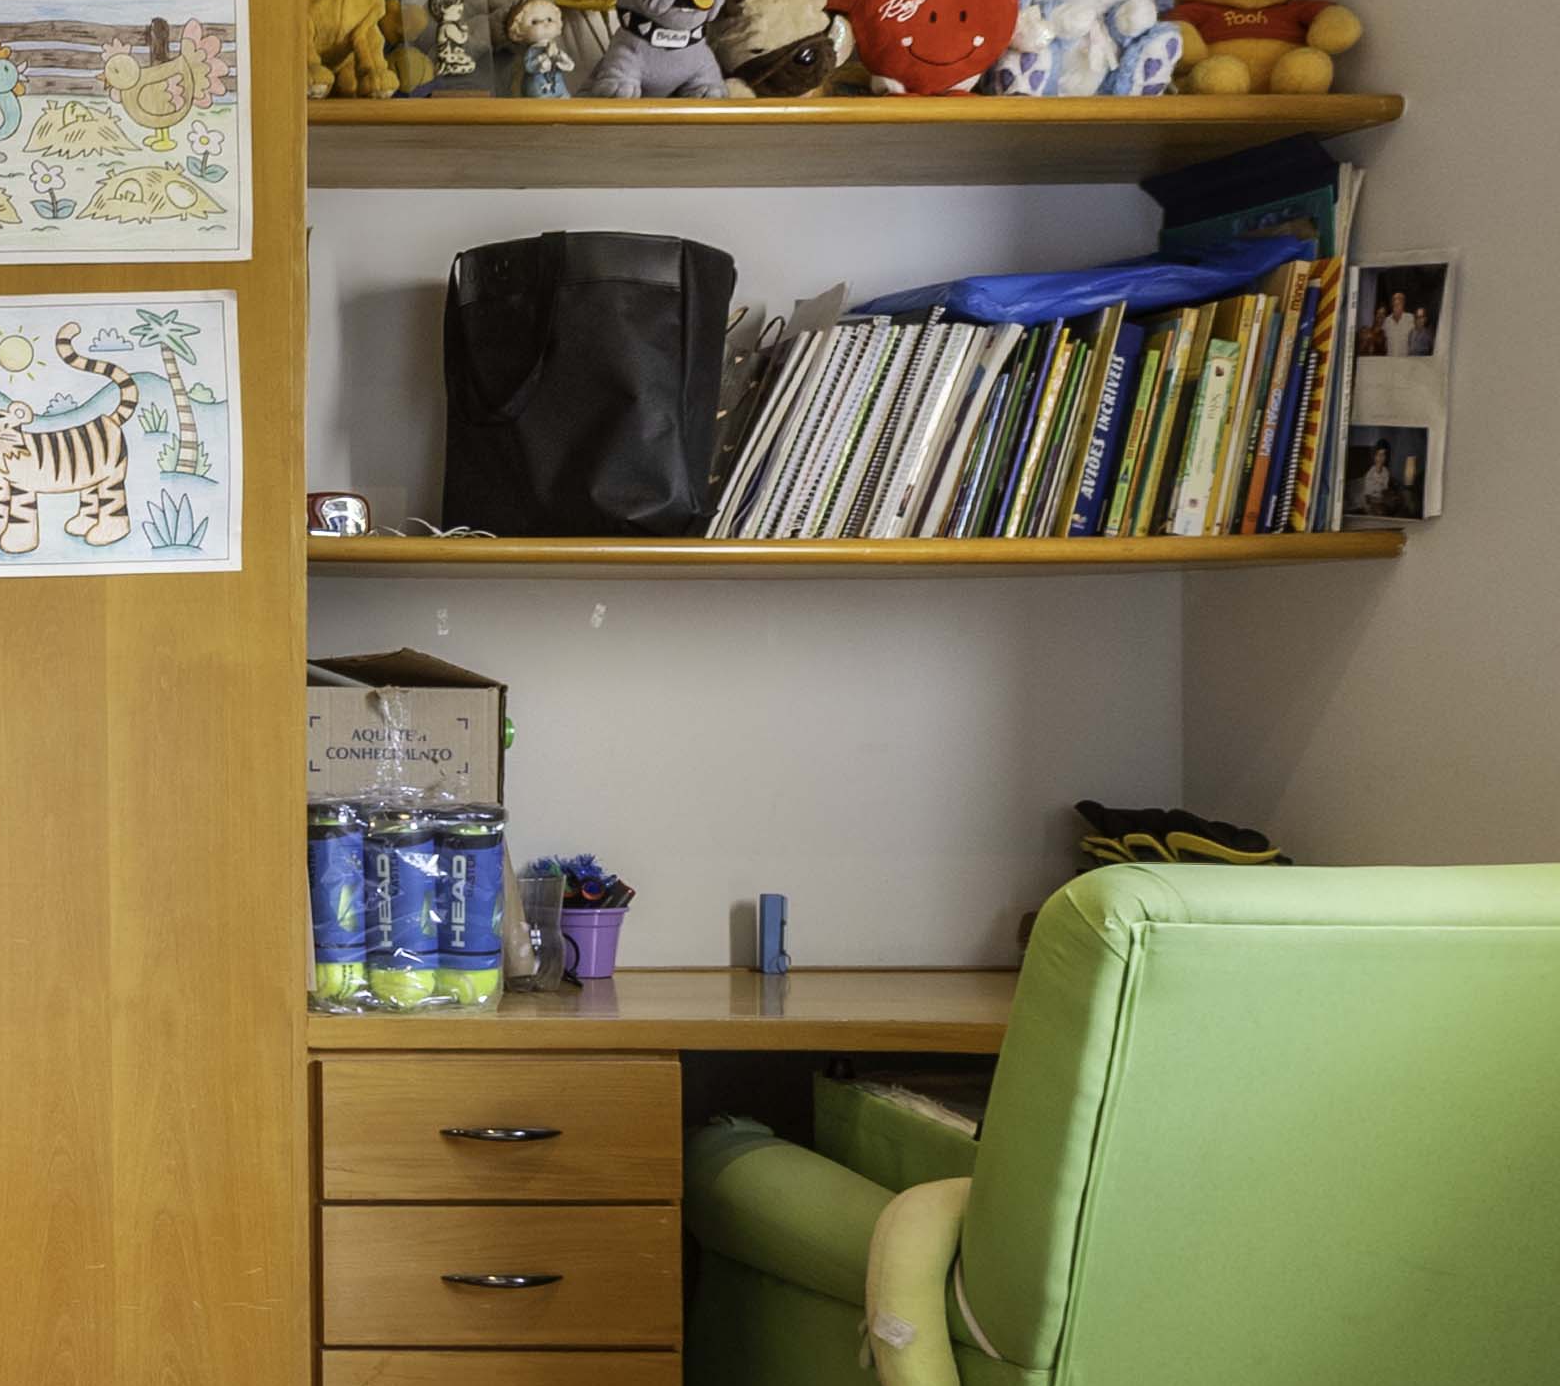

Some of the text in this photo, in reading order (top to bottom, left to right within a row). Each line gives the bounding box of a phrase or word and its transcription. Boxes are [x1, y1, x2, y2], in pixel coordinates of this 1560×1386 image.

[1223, 10, 1269, 27] Pooh
[376, 853, 393, 948] HEAD
[451, 855, 467, 948] HEAD
